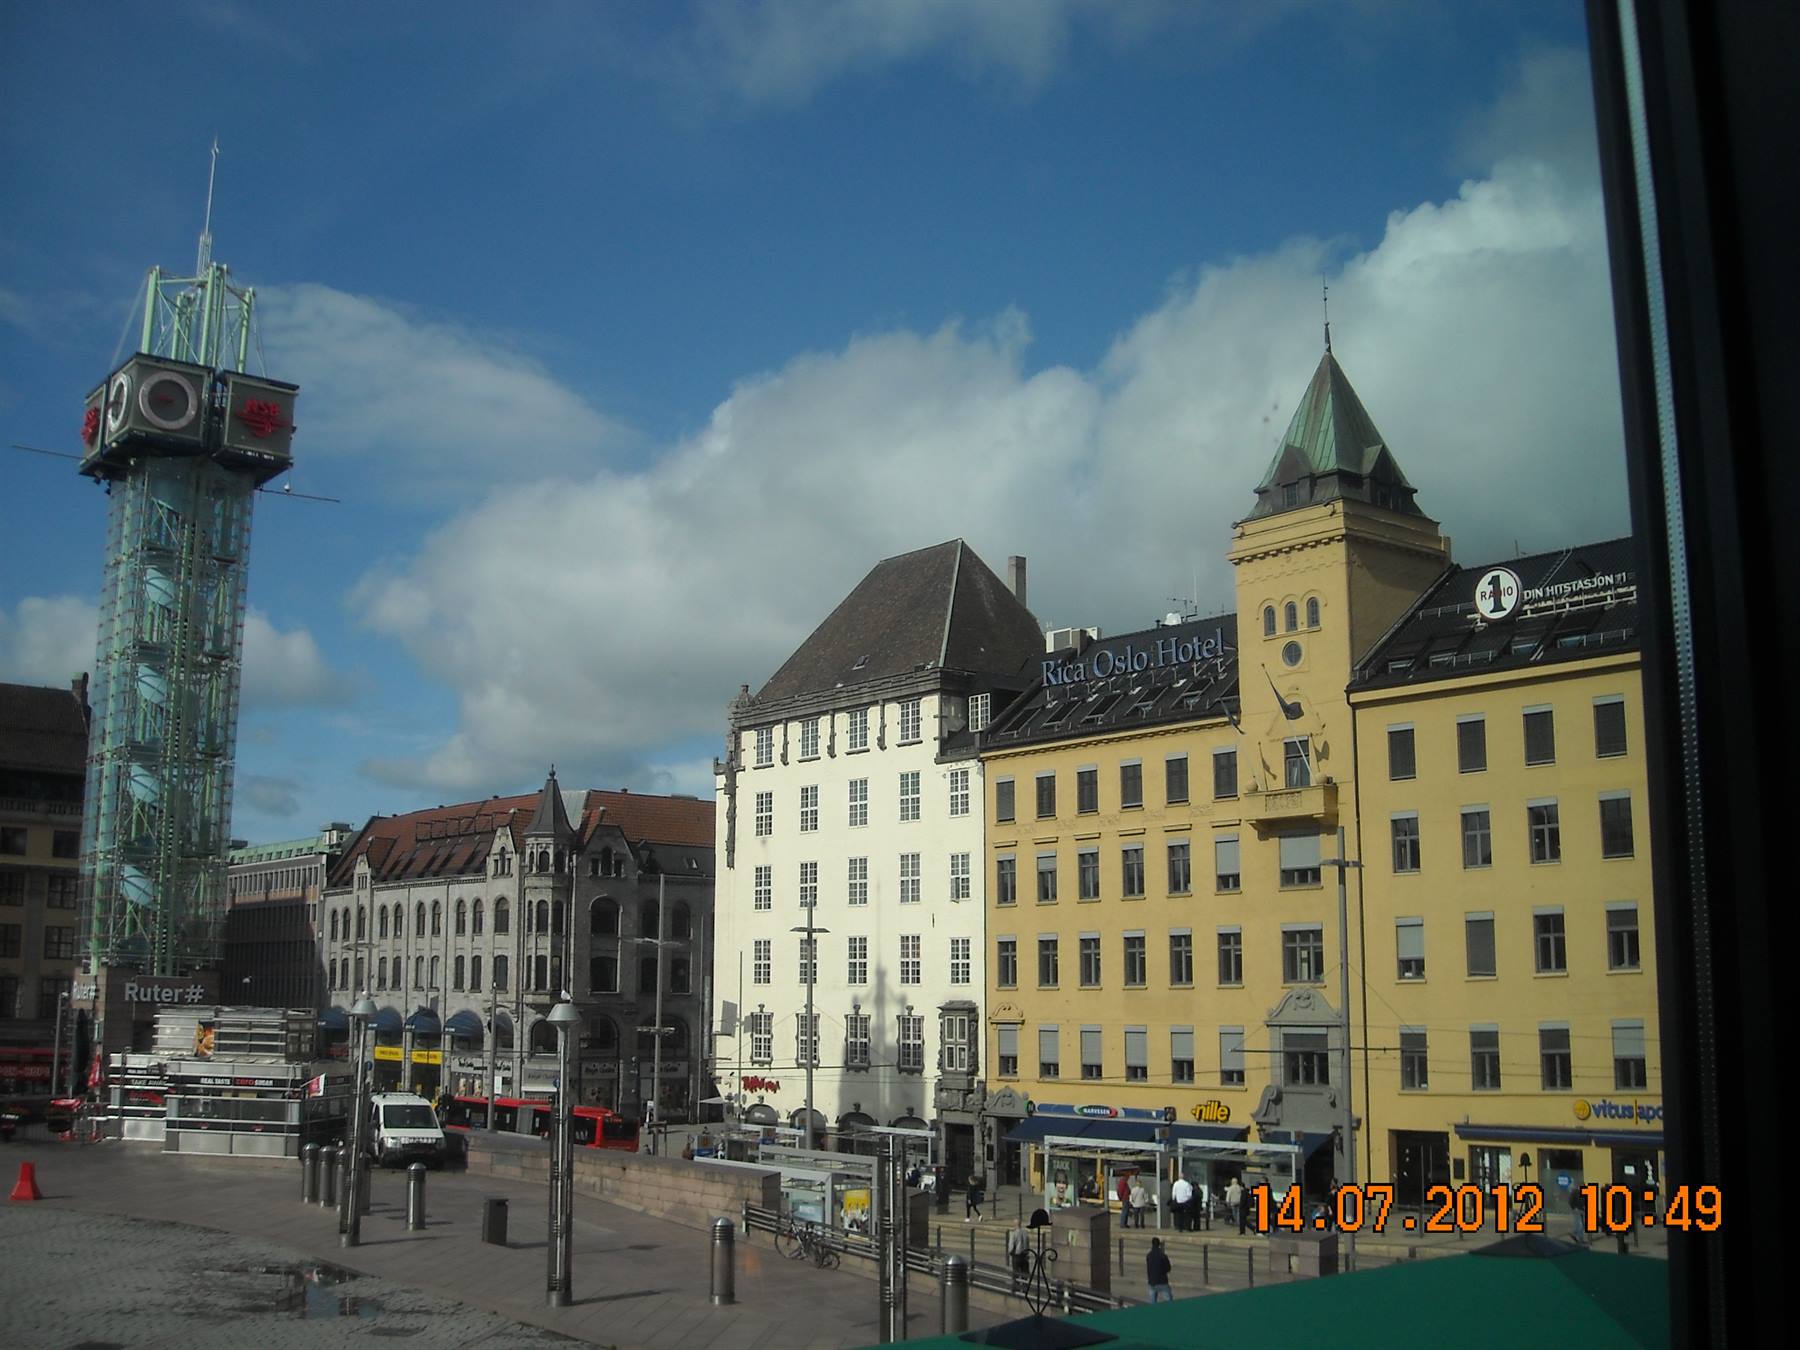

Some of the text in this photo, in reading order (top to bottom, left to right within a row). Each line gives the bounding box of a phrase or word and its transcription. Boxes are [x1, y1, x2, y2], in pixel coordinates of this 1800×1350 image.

[1480, 586, 1514, 601] RAIO
[1487, 574, 1507, 614] 1
[1523, 588, 1543, 601] DIN
[1545, 574, 1614, 597] HITSTASJON
[1041, 628, 1224, 687] Rica Oslo Hotel
[124, 982, 205, 1003] Ruter#
[1195, 1100, 1231, 1122] nille
[1592, 1098, 1634, 1119] vitus
